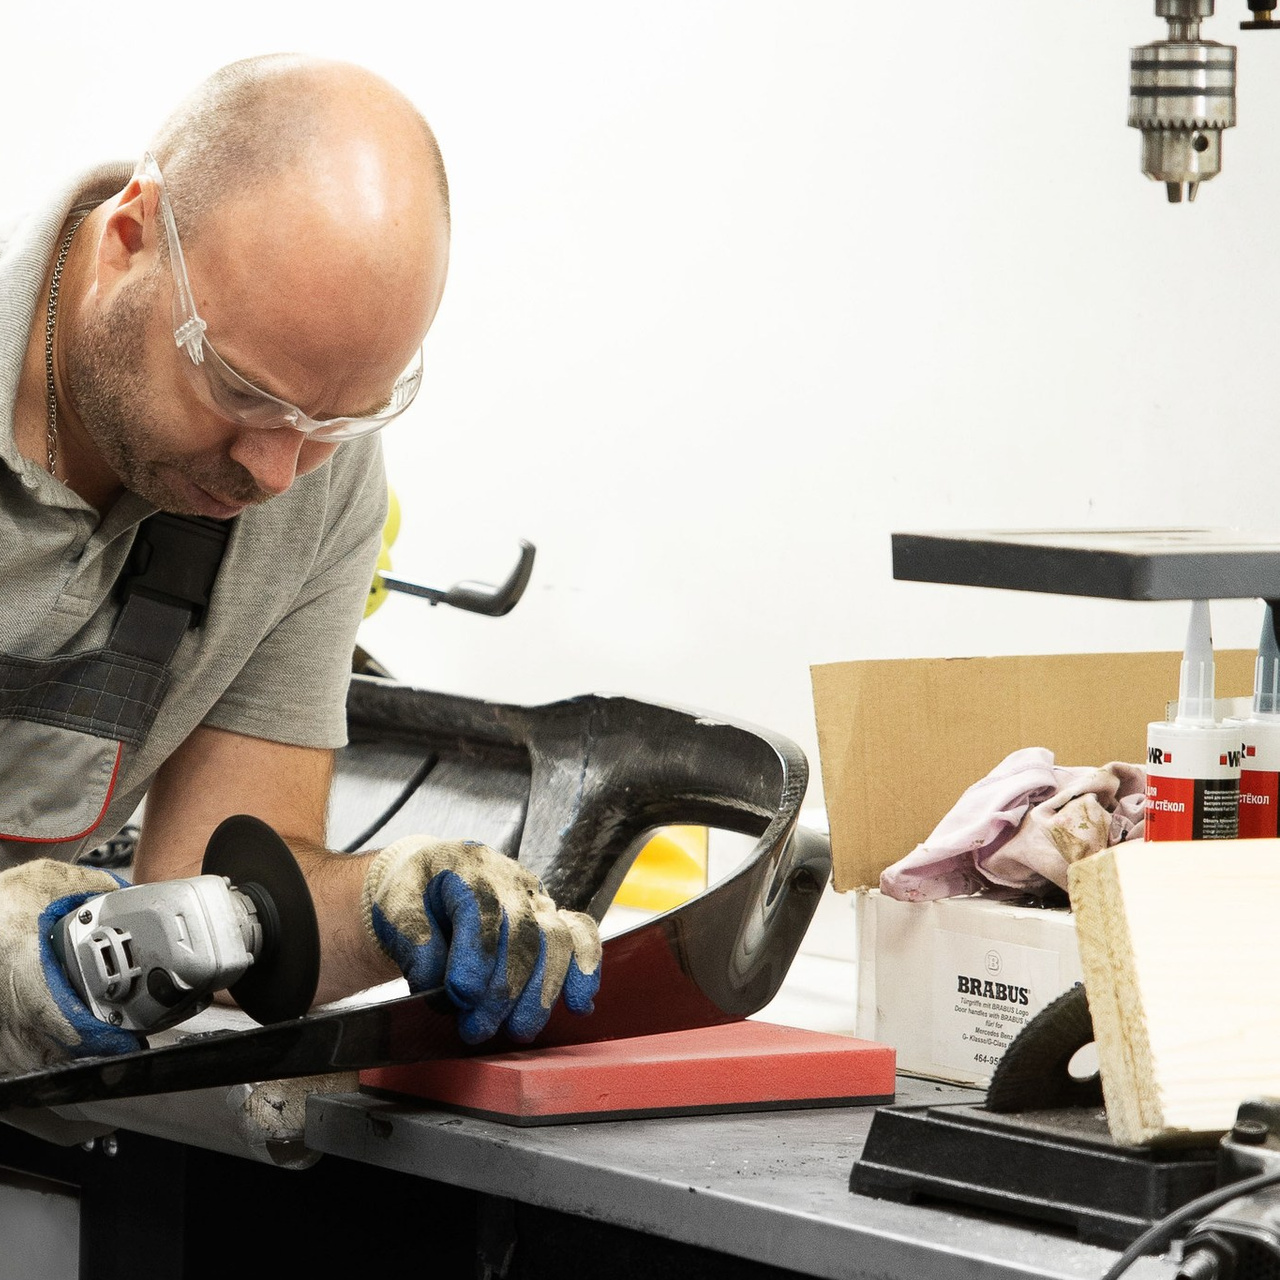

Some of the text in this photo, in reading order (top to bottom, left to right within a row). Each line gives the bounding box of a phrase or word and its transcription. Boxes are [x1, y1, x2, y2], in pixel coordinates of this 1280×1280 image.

[1155, 800, 1185, 813] СТЁКОЛ
[957, 975, 1029, 1006] BRABUS
[954, 1005, 967, 1013] Door
[968, 1007, 988, 1018] handles
[988, 1012, 1000, 1020] with
[1000, 1014, 1024, 1025] BRABUS
[960, 997, 982, 1007] Türgriffe
[991, 1003, 1015, 1014] BRABUS
[1015, 1008, 1029, 1017] Logo
[975, 1027, 1014, 1040] Mercedes Benz
